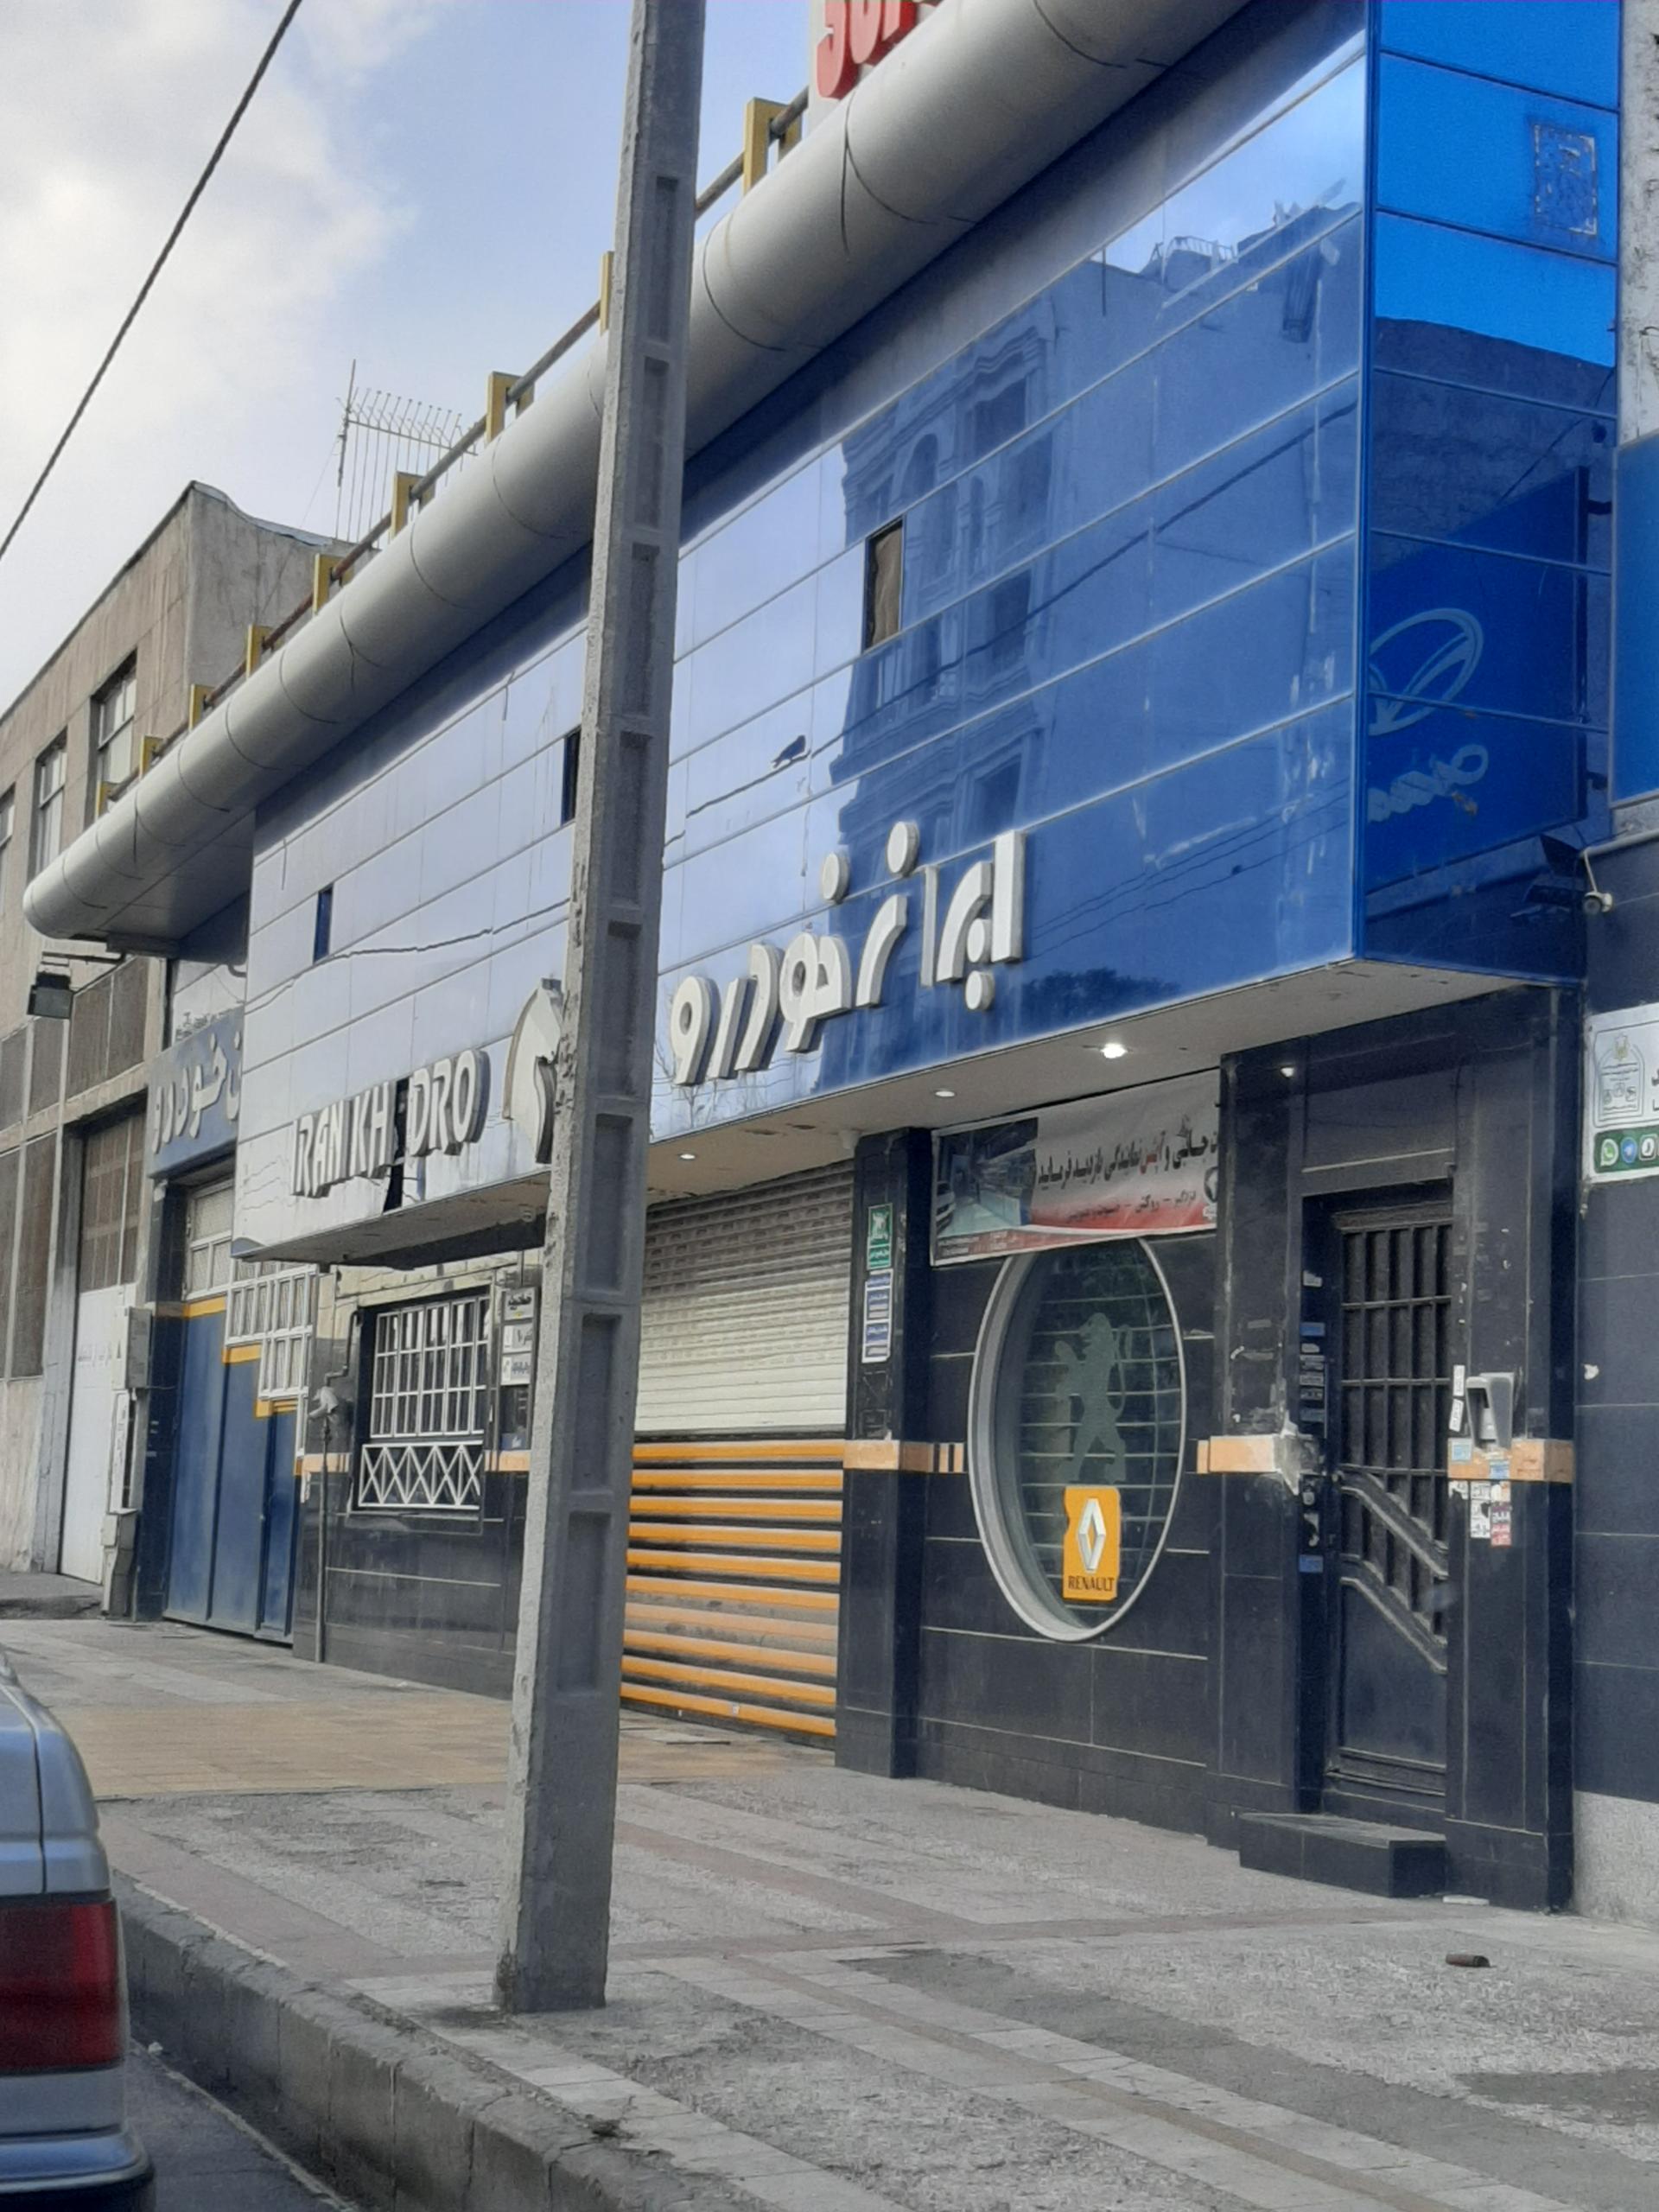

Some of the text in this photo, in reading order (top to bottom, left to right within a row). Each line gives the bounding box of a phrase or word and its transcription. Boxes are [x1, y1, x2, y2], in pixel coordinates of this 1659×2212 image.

[669, 819, 1027, 1087] ایران خودرو
[152, 1033, 228, 1154] خودرو
[289, 1097, 351, 1199] IRAN
[1067, 1574, 1115, 1592] RENAULT
